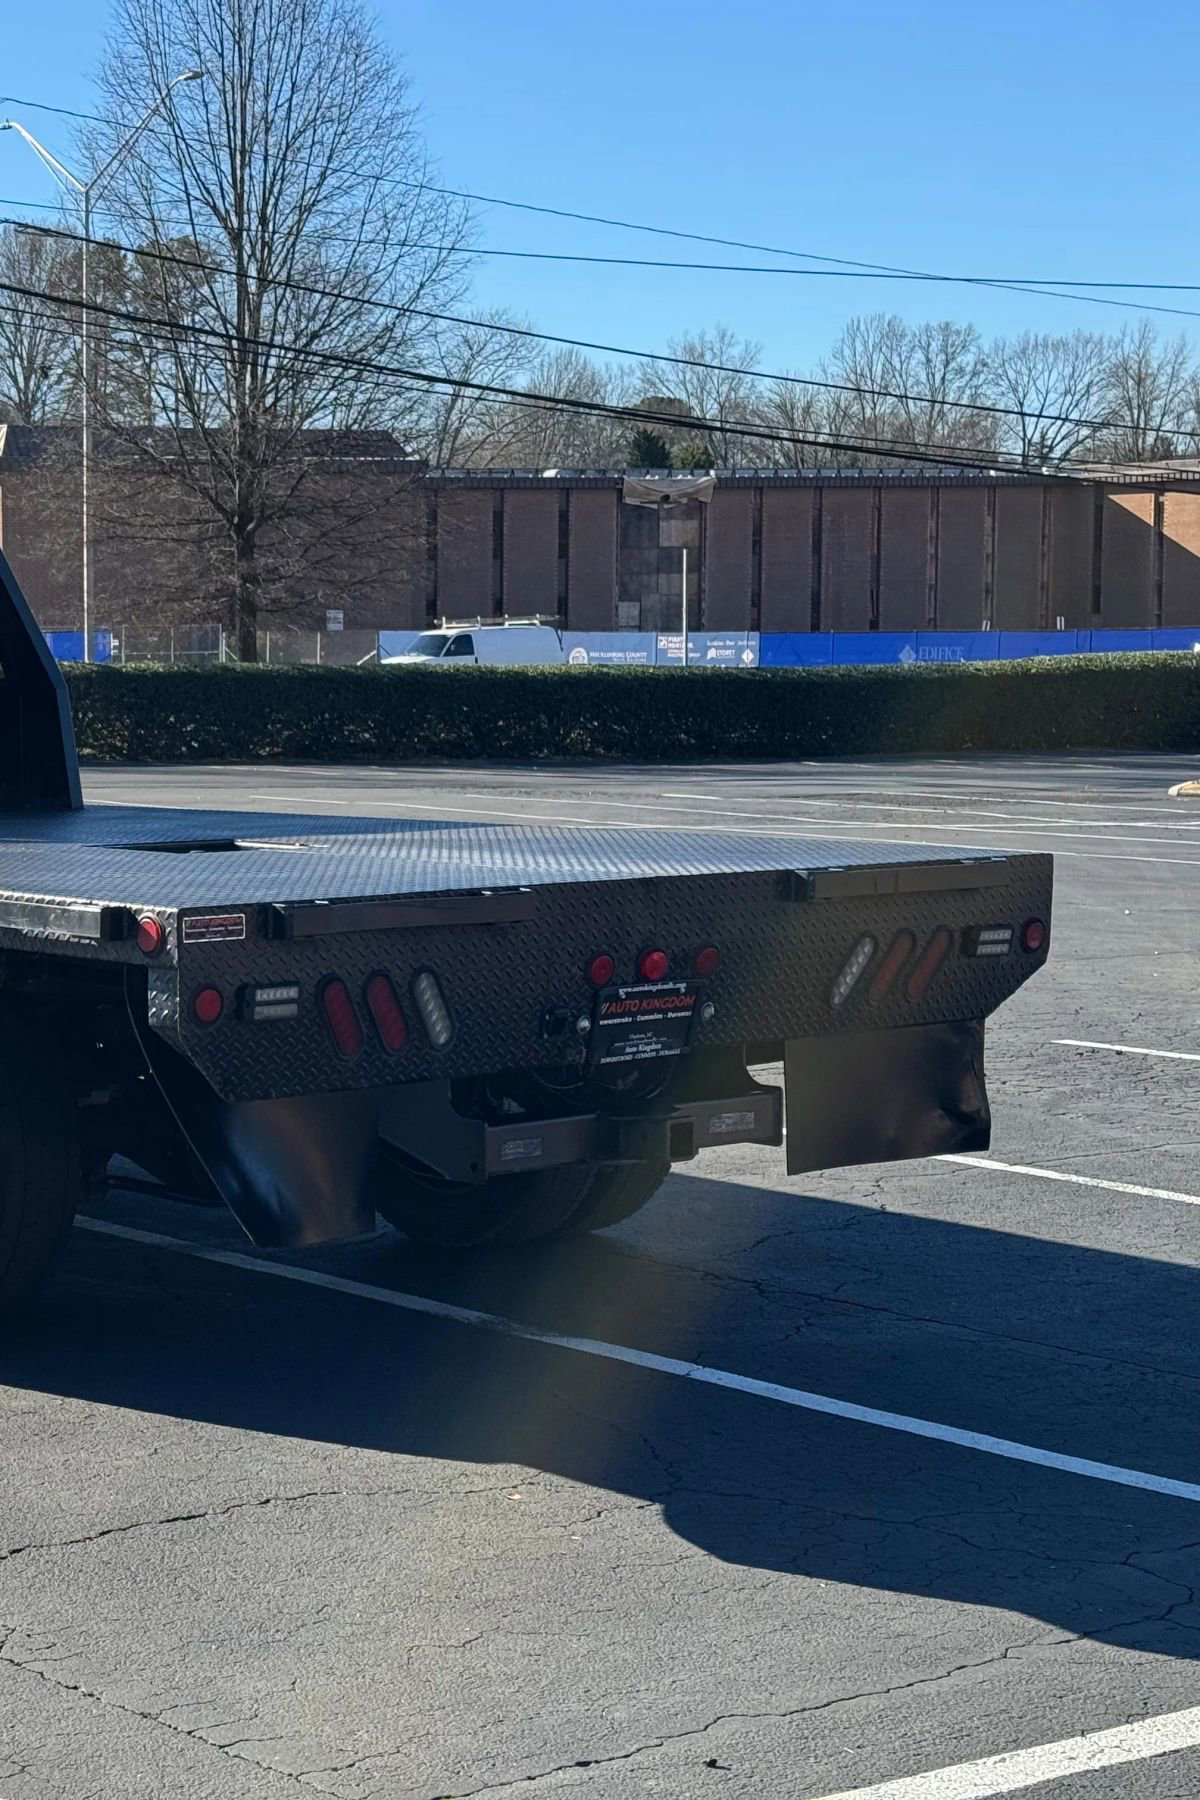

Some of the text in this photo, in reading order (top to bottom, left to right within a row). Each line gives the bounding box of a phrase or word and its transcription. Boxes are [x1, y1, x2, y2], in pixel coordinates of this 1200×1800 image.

[920, 646, 964, 660] EDIFICE
[607, 995, 697, 1014] AUTO KINGDOM
